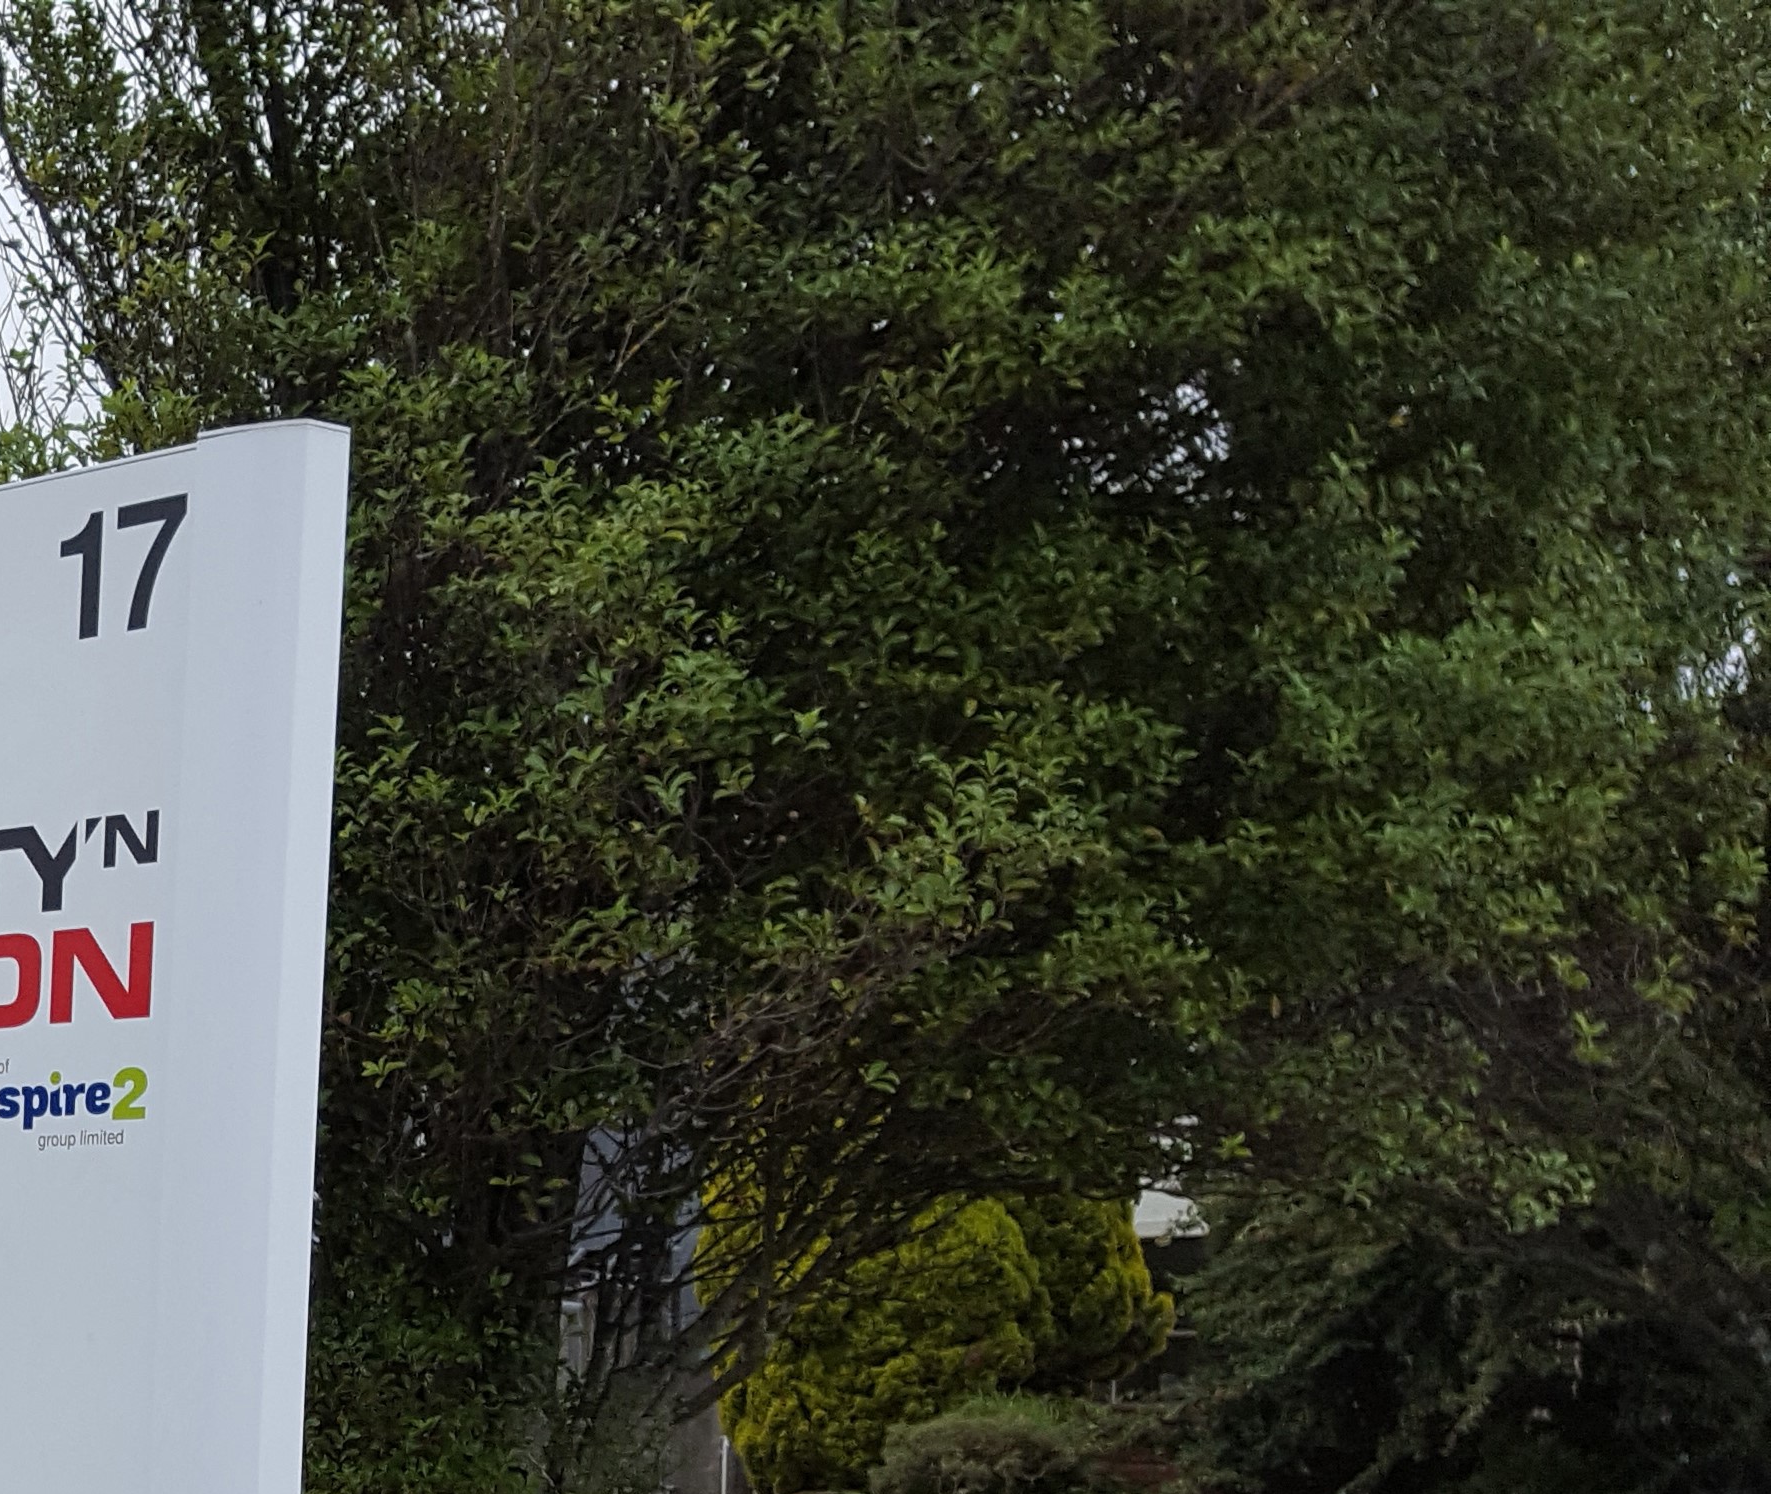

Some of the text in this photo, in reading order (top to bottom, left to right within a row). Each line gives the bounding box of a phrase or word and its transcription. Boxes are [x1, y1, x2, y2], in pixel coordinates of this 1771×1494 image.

[60, 493, 188, 640] 17
[38, 1129, 124, 1150] group limited
